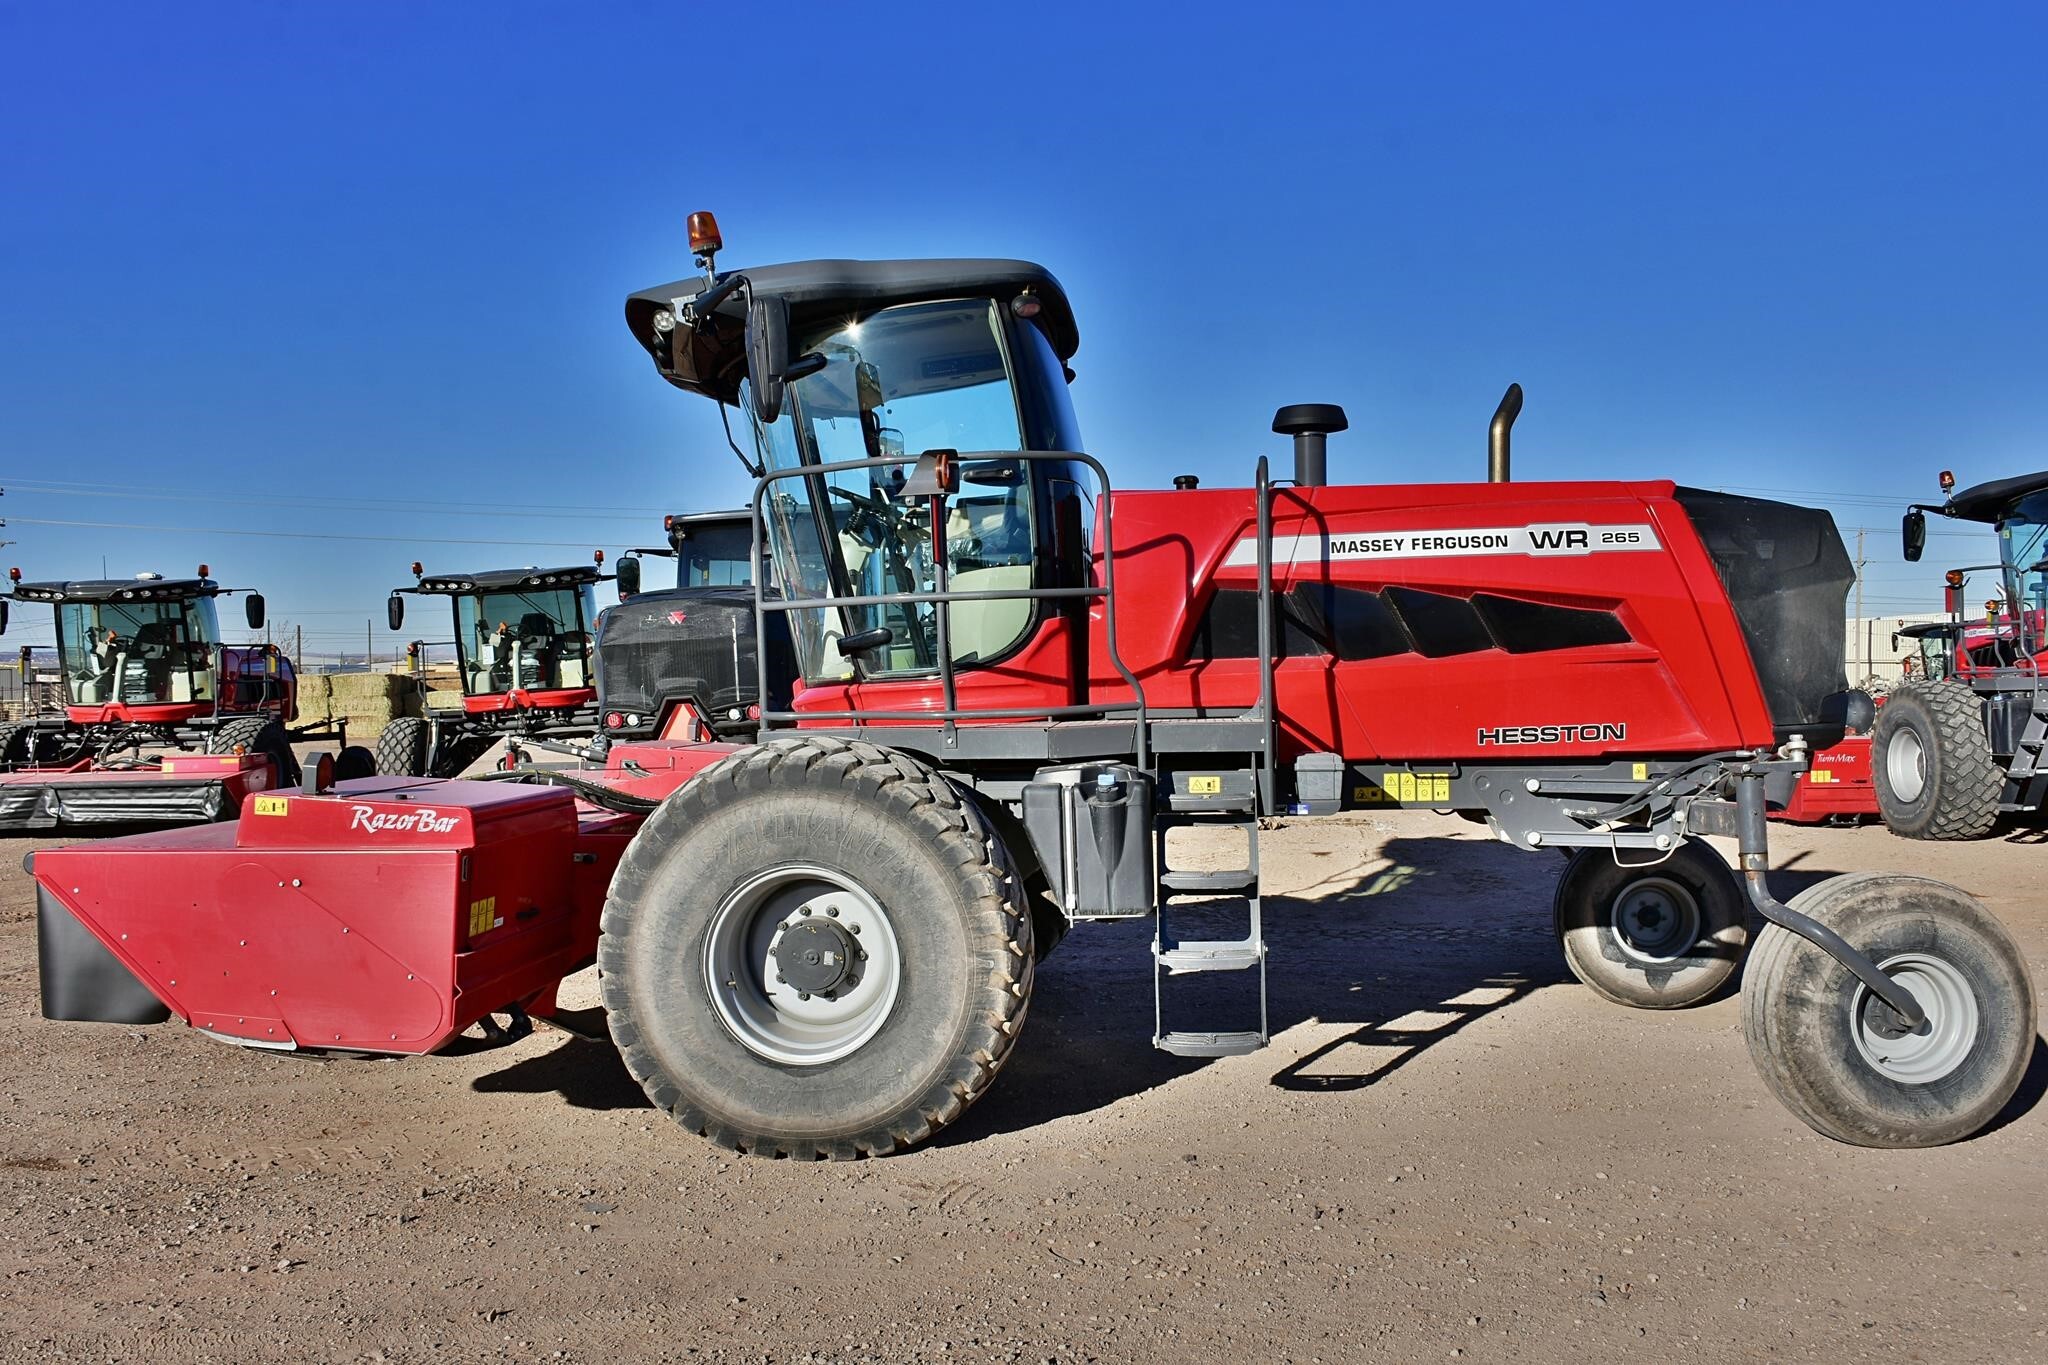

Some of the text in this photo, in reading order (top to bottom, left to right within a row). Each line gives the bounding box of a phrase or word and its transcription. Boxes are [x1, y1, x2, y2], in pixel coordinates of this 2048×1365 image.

[1331, 529, 1640, 554] MASSEY FERGUSON WR 265
[1478, 723, 1626, 745] HESSTON
[1836, 753, 1856, 763] Max
